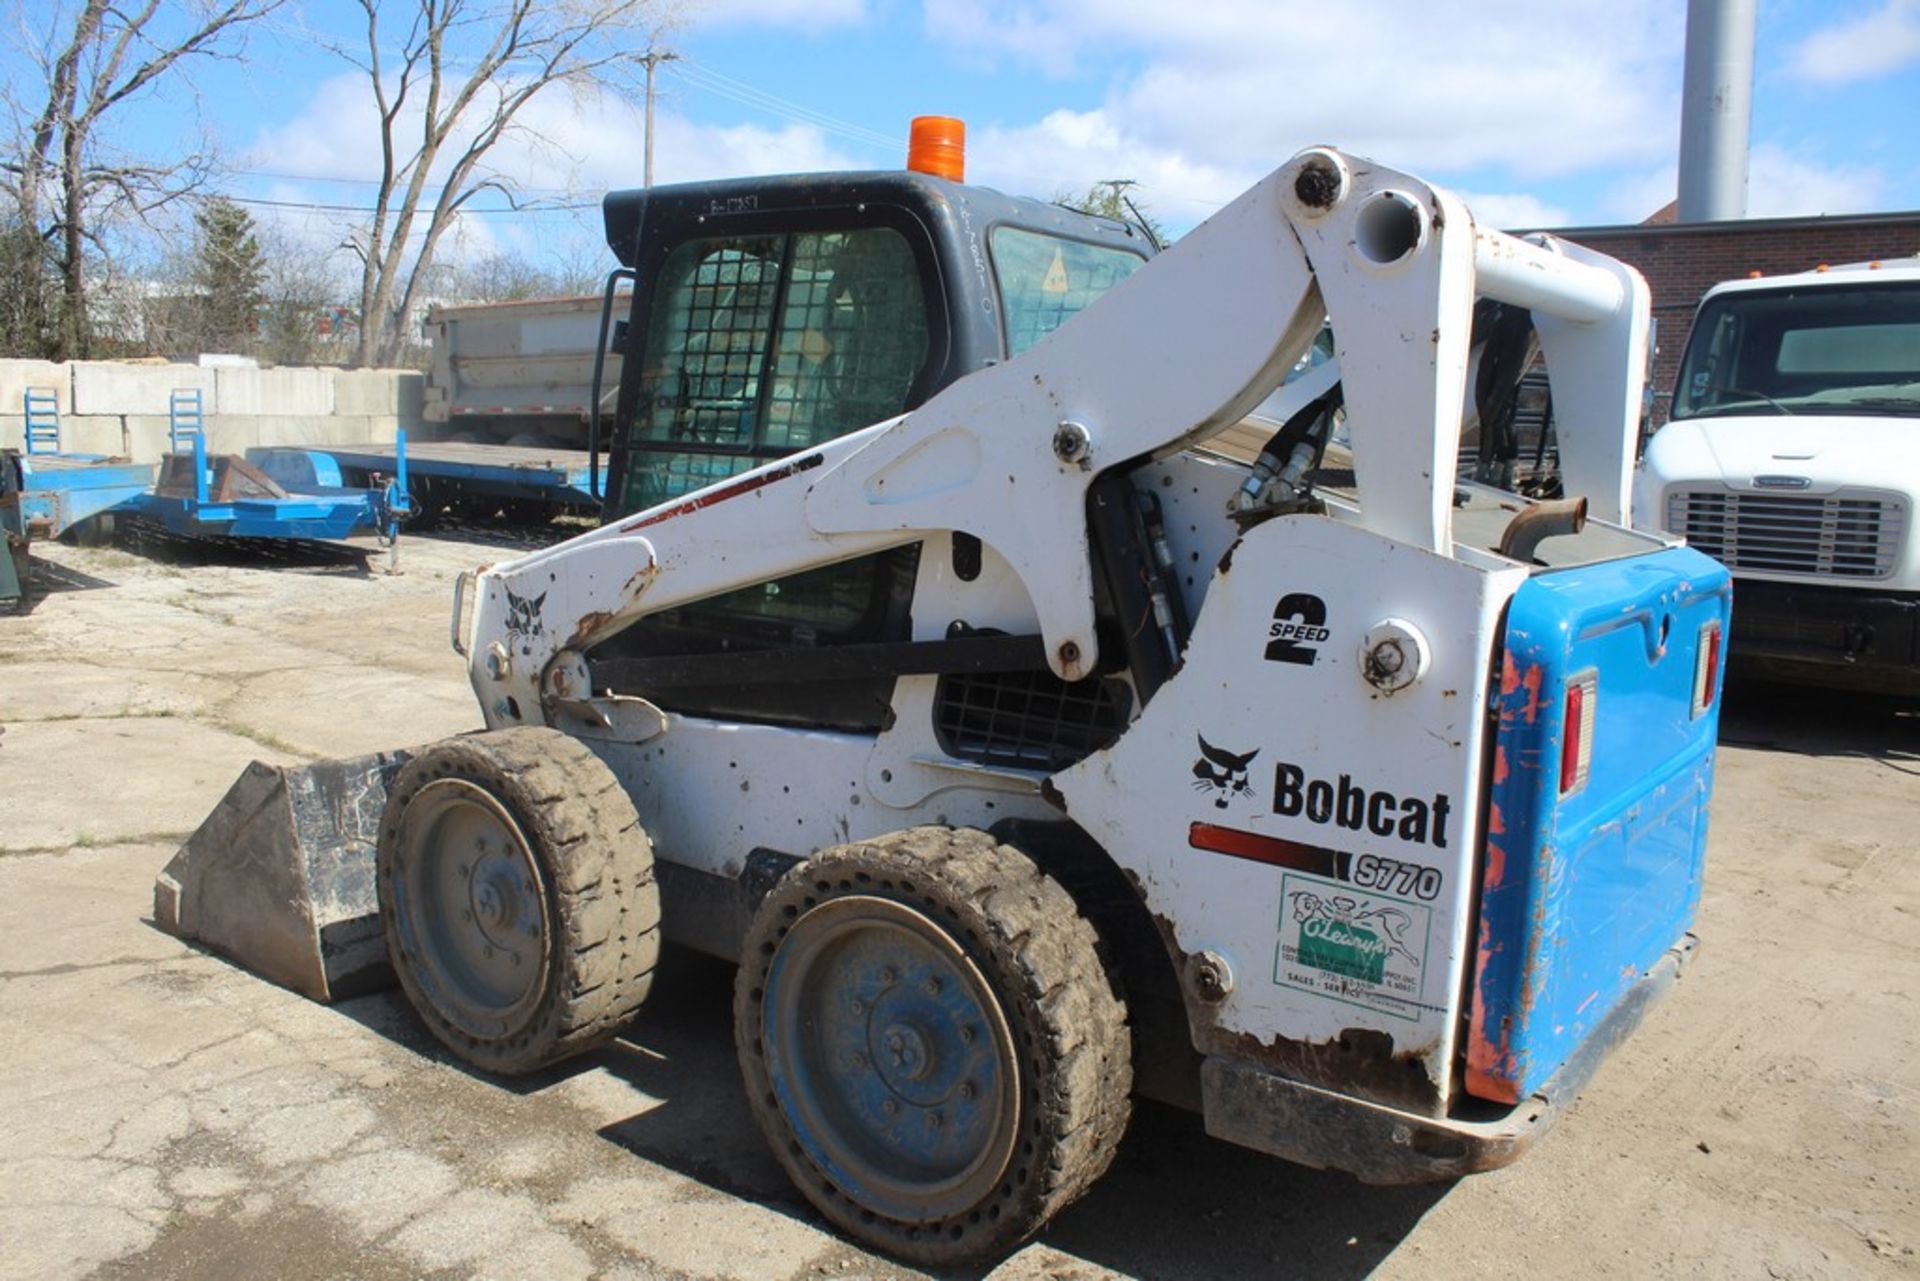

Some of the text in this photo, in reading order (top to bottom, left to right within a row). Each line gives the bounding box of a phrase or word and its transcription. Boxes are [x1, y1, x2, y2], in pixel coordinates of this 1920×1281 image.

[1264, 592, 1327, 667] 2
[1269, 622, 1331, 642] SPEED
[1272, 762, 1451, 848] Bobcat
[1354, 854, 1443, 901] S770
[1287, 972, 1315, 986] SALES
[1323, 981, 1361, 999] SERICE
